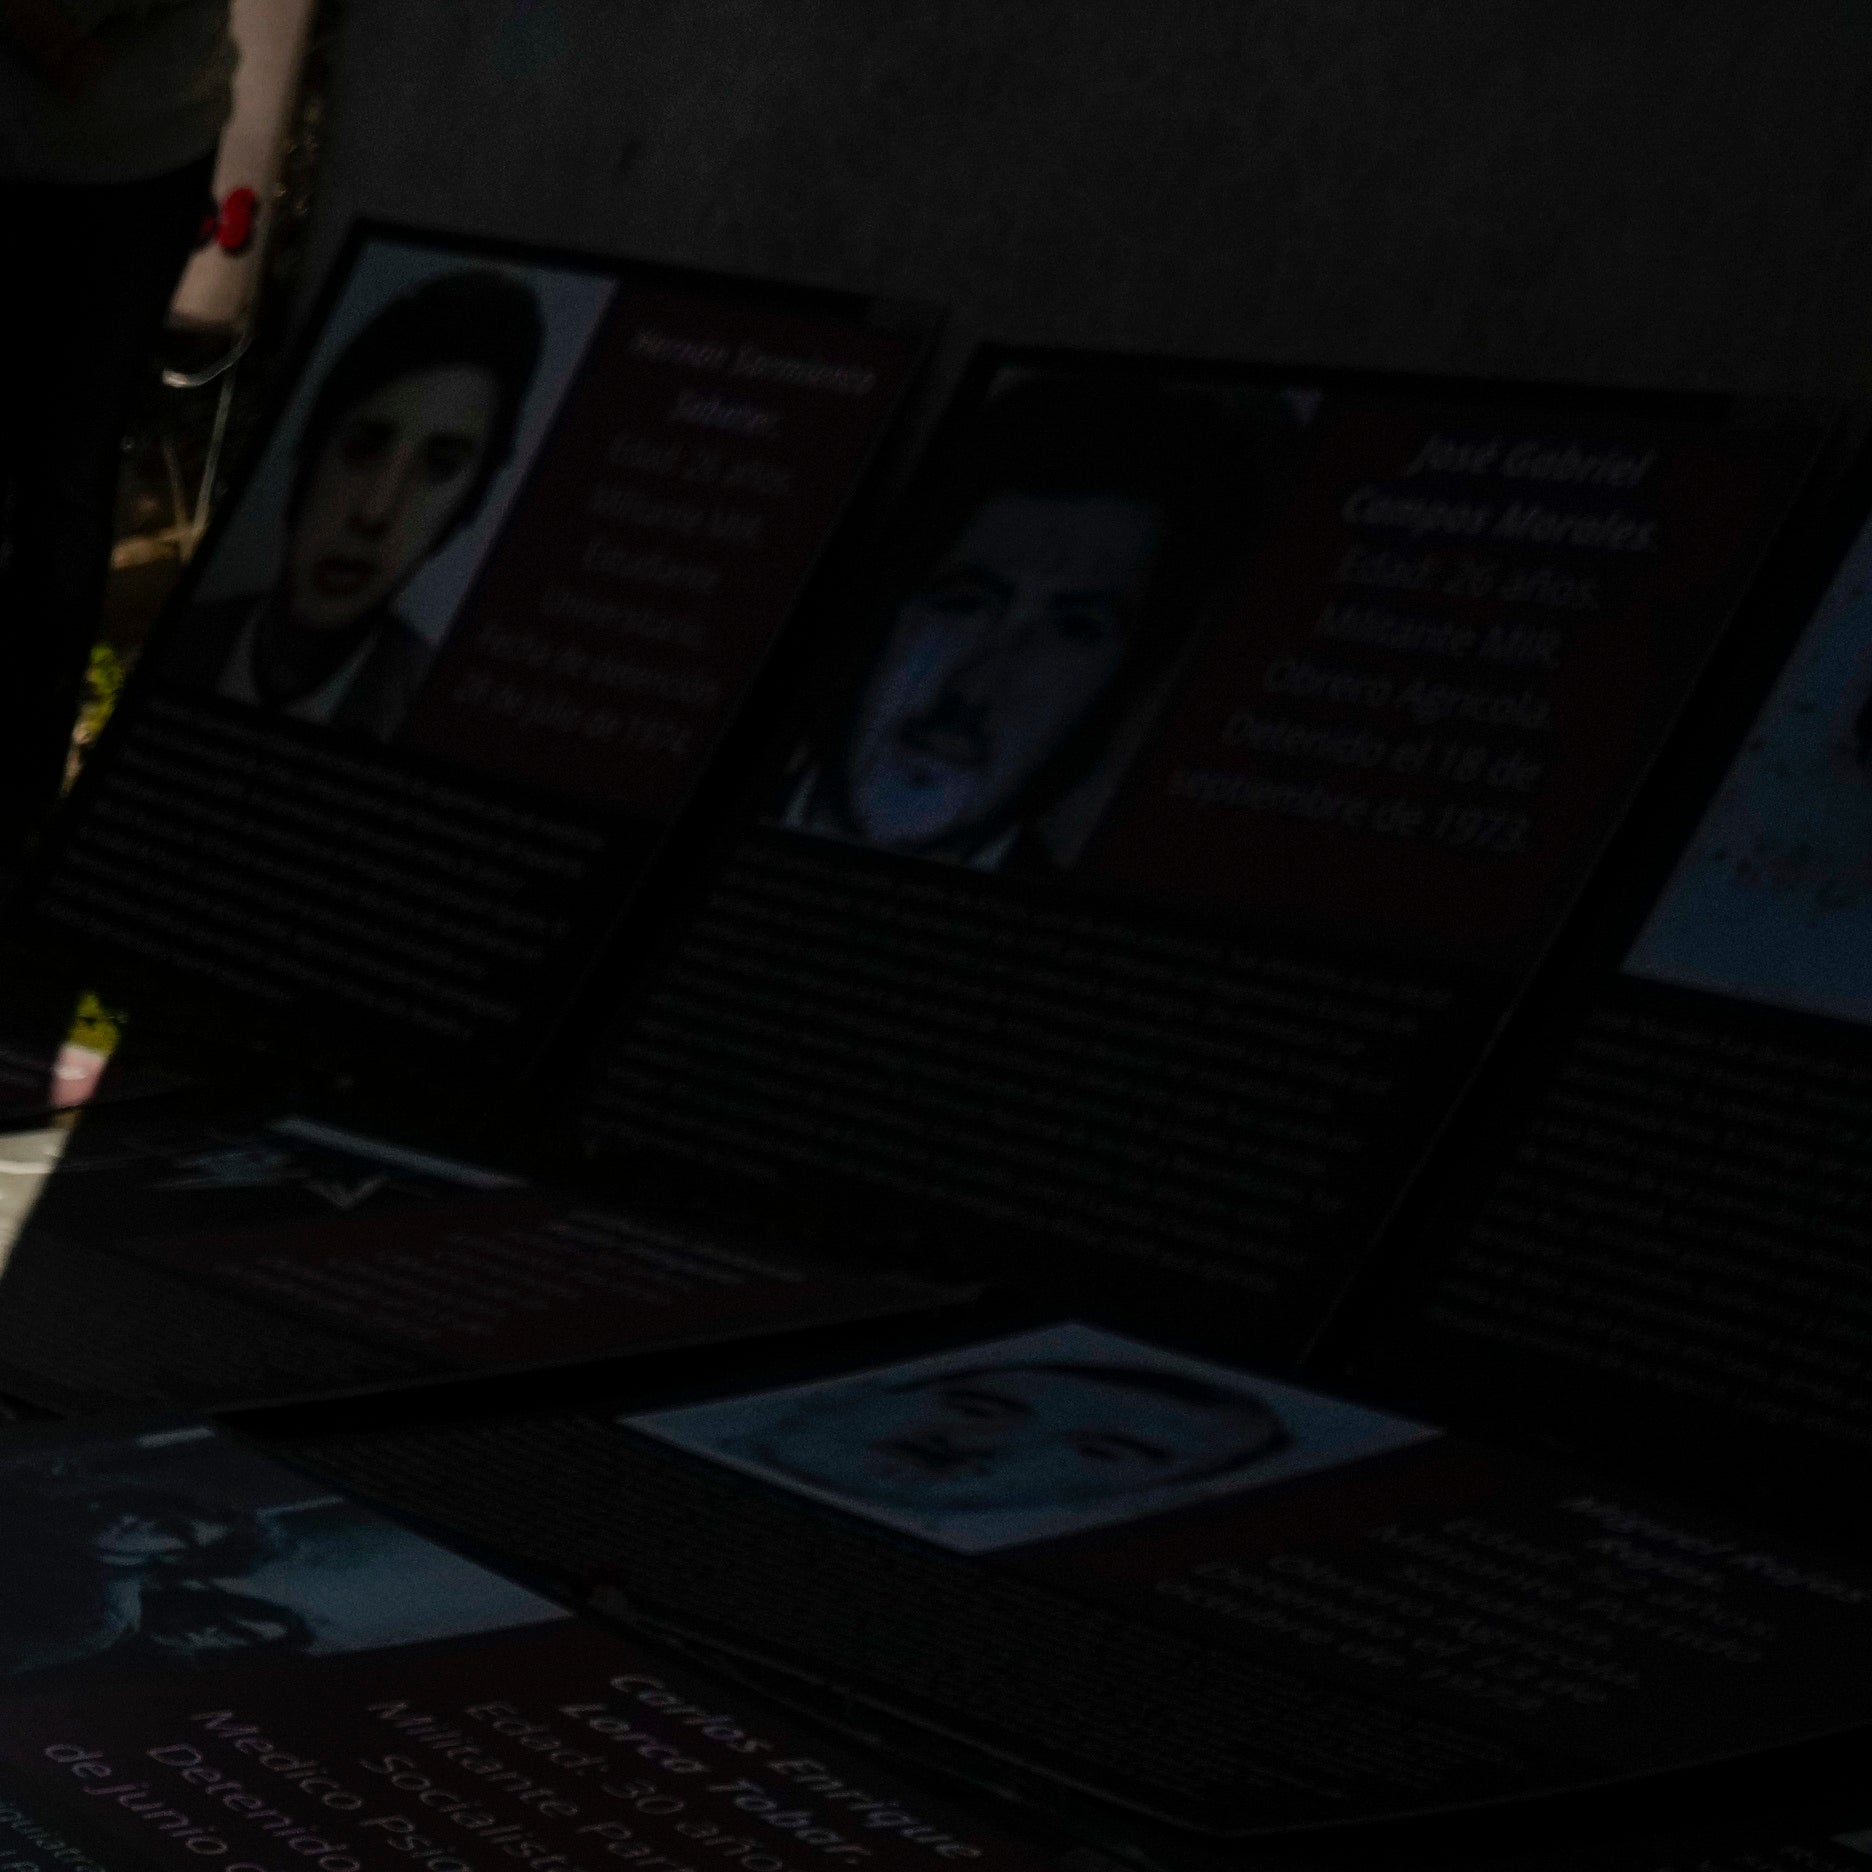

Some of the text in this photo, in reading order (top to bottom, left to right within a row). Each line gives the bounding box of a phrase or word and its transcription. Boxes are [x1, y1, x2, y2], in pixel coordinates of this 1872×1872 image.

[44, 1744, 112, 1778] de
[83, 1781, 228, 1855] junio
[146, 1743, 361, 1872] Detenido
[367, 1700, 579, 1818] Militante
[465, 1701, 608, 1777] Edad:
[601, 1779, 685, 1814] 30
[559, 1702, 872, 1865] Lorca Tobar.
[610, 1675, 982, 1859] Carlos Enrique
